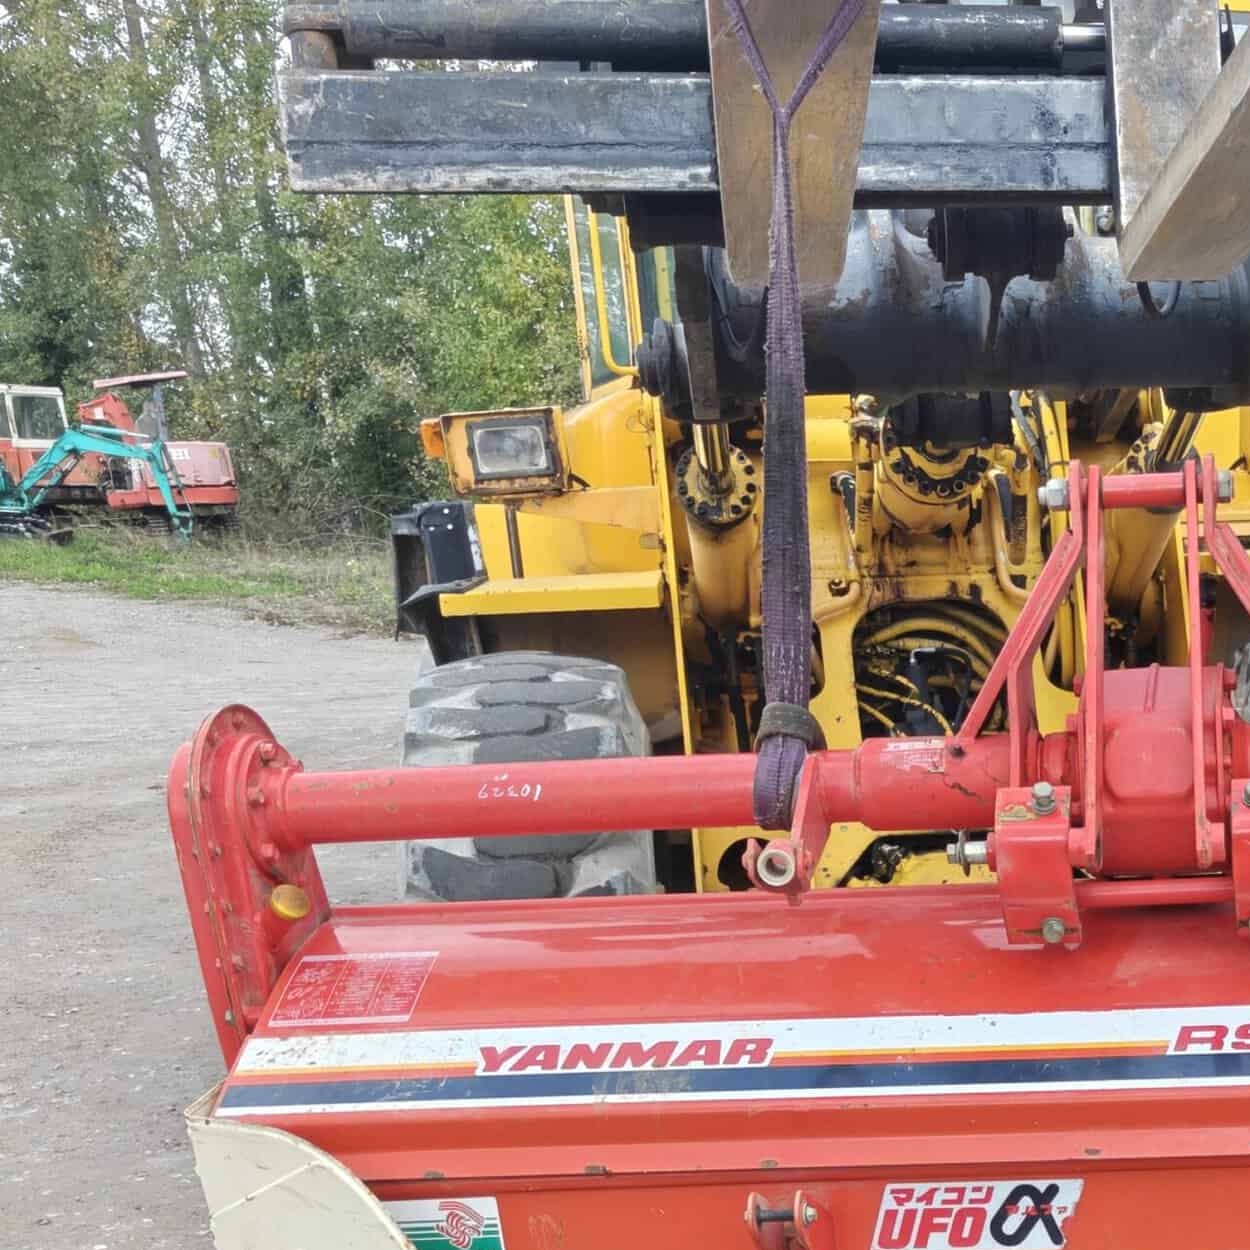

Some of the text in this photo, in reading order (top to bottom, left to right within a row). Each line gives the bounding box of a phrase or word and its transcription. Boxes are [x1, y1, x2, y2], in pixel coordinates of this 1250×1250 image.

[479, 1038, 774, 1073] YANMAR
[889, 1185, 995, 1207] マイコン
[877, 1206, 988, 1250] UFO
